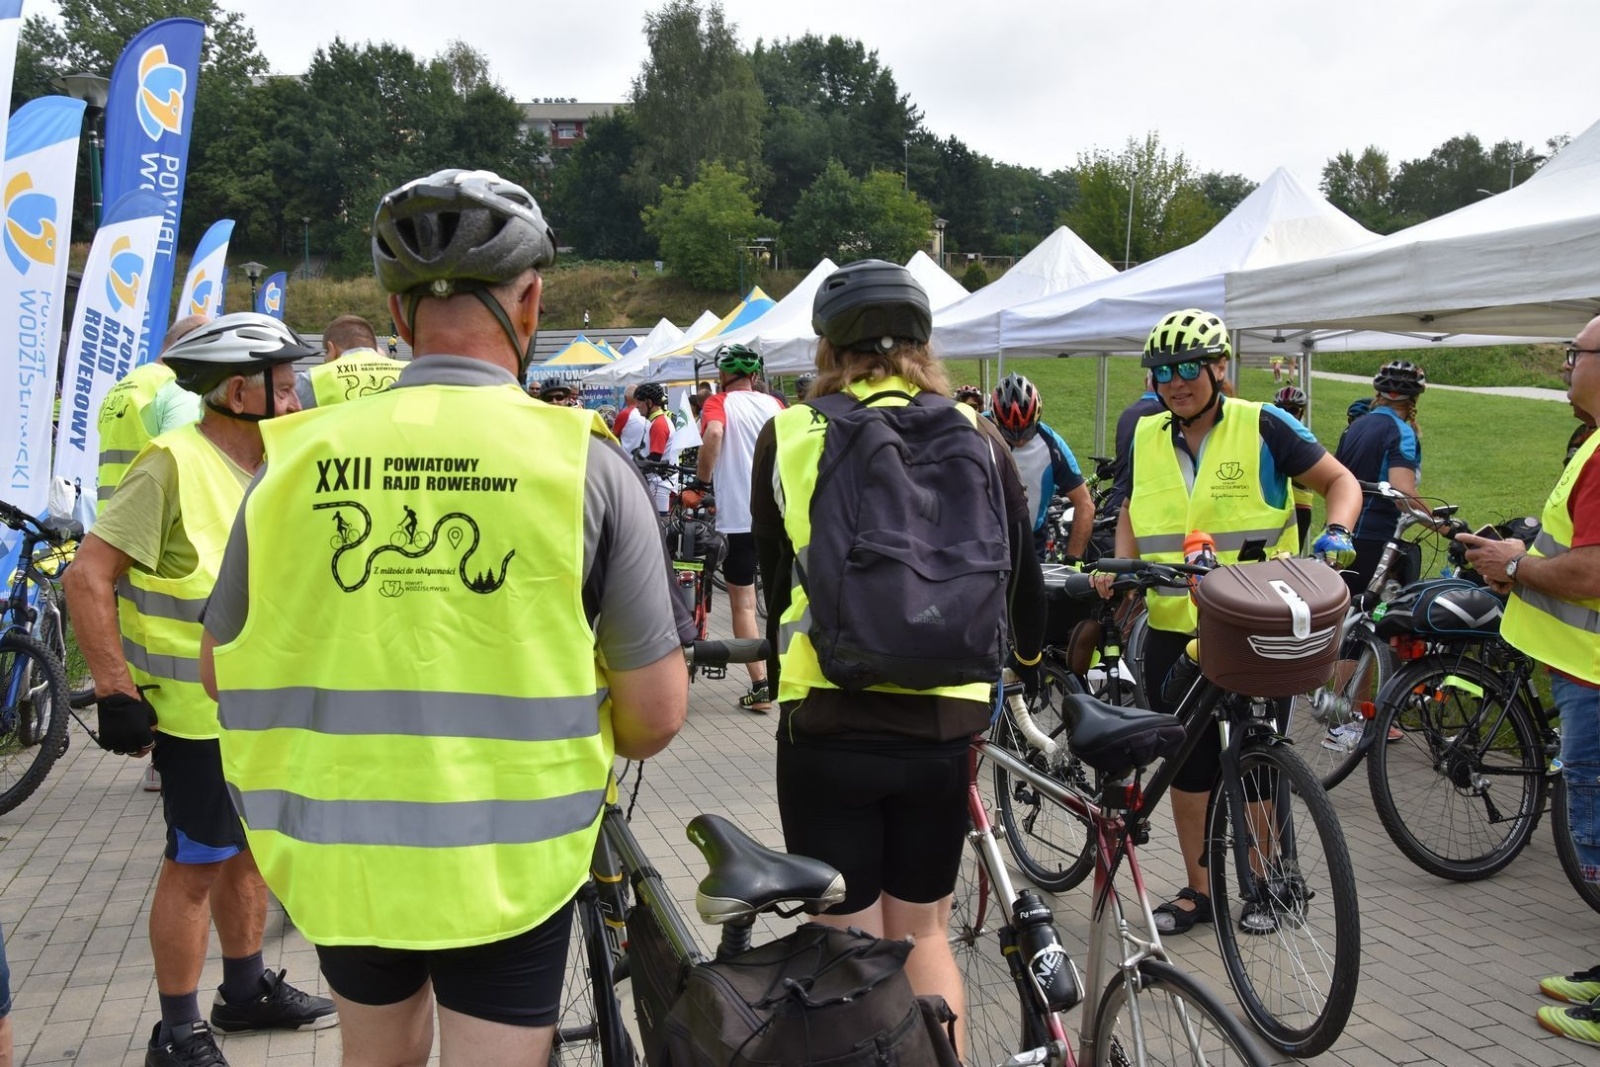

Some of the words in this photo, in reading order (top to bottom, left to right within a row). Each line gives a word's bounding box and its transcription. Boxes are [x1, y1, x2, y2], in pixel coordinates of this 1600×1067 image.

[97, 315, 121, 375] RAJD
[336, 363, 358, 374] XXII
[69, 306, 103, 453] ROWEROWY
[383, 457, 480, 473] POWIATOWY
[315, 457, 372, 494] XXII
[382, 475, 420, 491] RAJD
[426, 476, 518, 493] ROWEROWY
[373, 567, 380, 575] Z
[380, 567, 405, 575] miłości
[415, 567, 456, 576] aktywności
